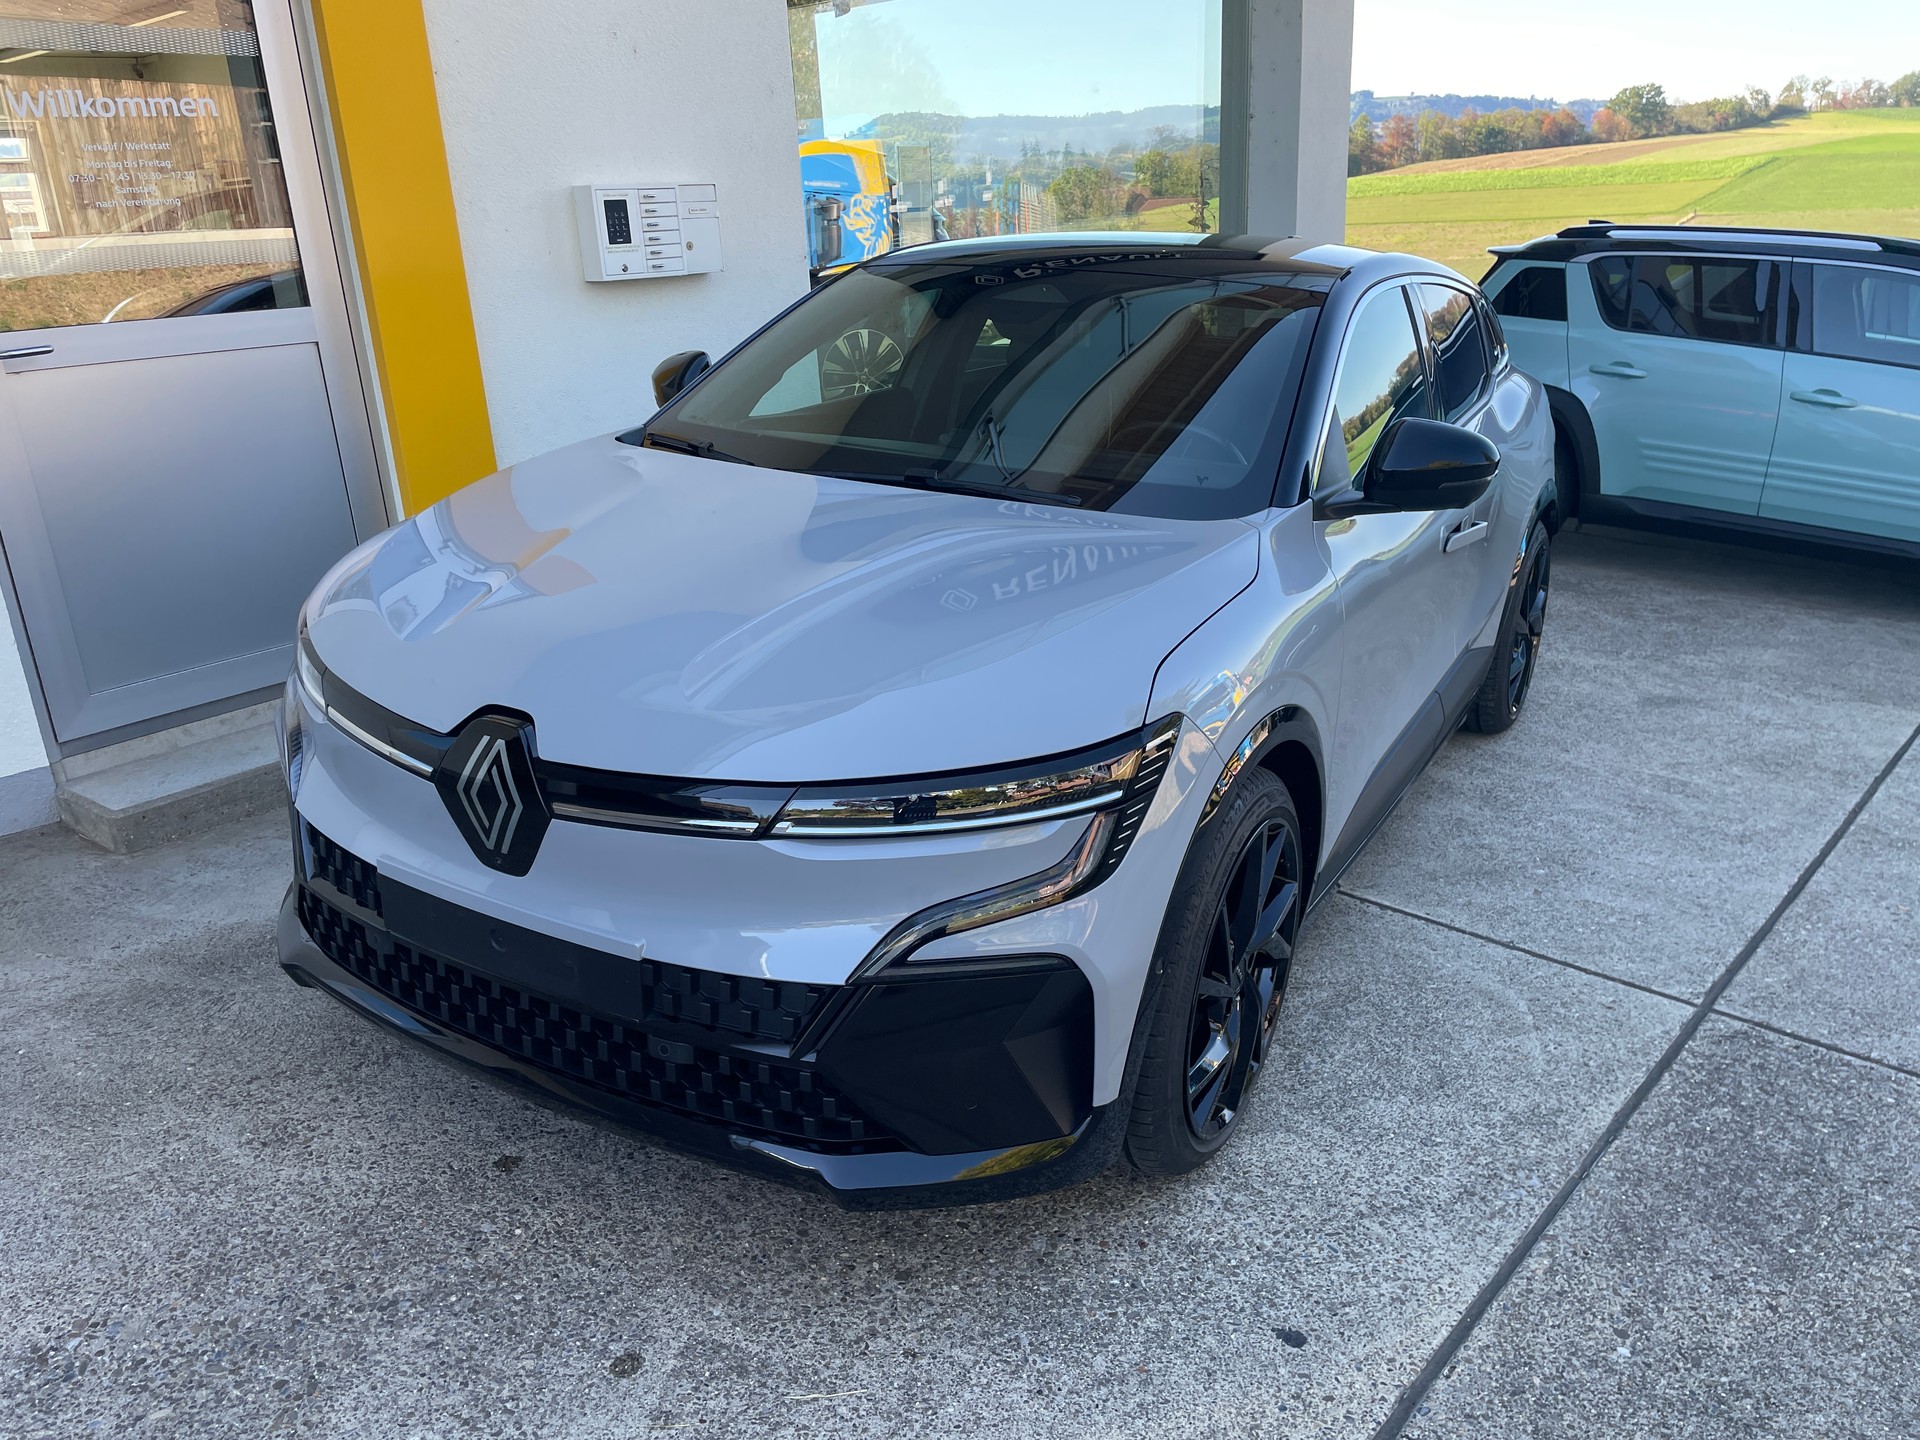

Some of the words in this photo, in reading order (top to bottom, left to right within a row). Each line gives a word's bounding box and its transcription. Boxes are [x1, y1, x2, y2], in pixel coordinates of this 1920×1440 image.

[5, 88, 219, 118] Willkommen
[82, 142, 118, 152] Verkauf
[125, 142, 171, 151] Werkstatt
[86, 160, 122, 169] Montag
[124, 159, 138, 168] bis
[140, 159, 174, 169] Freitag:
[95, 199, 120, 208] nach
[121, 197, 181, 207] Vereinbarung
